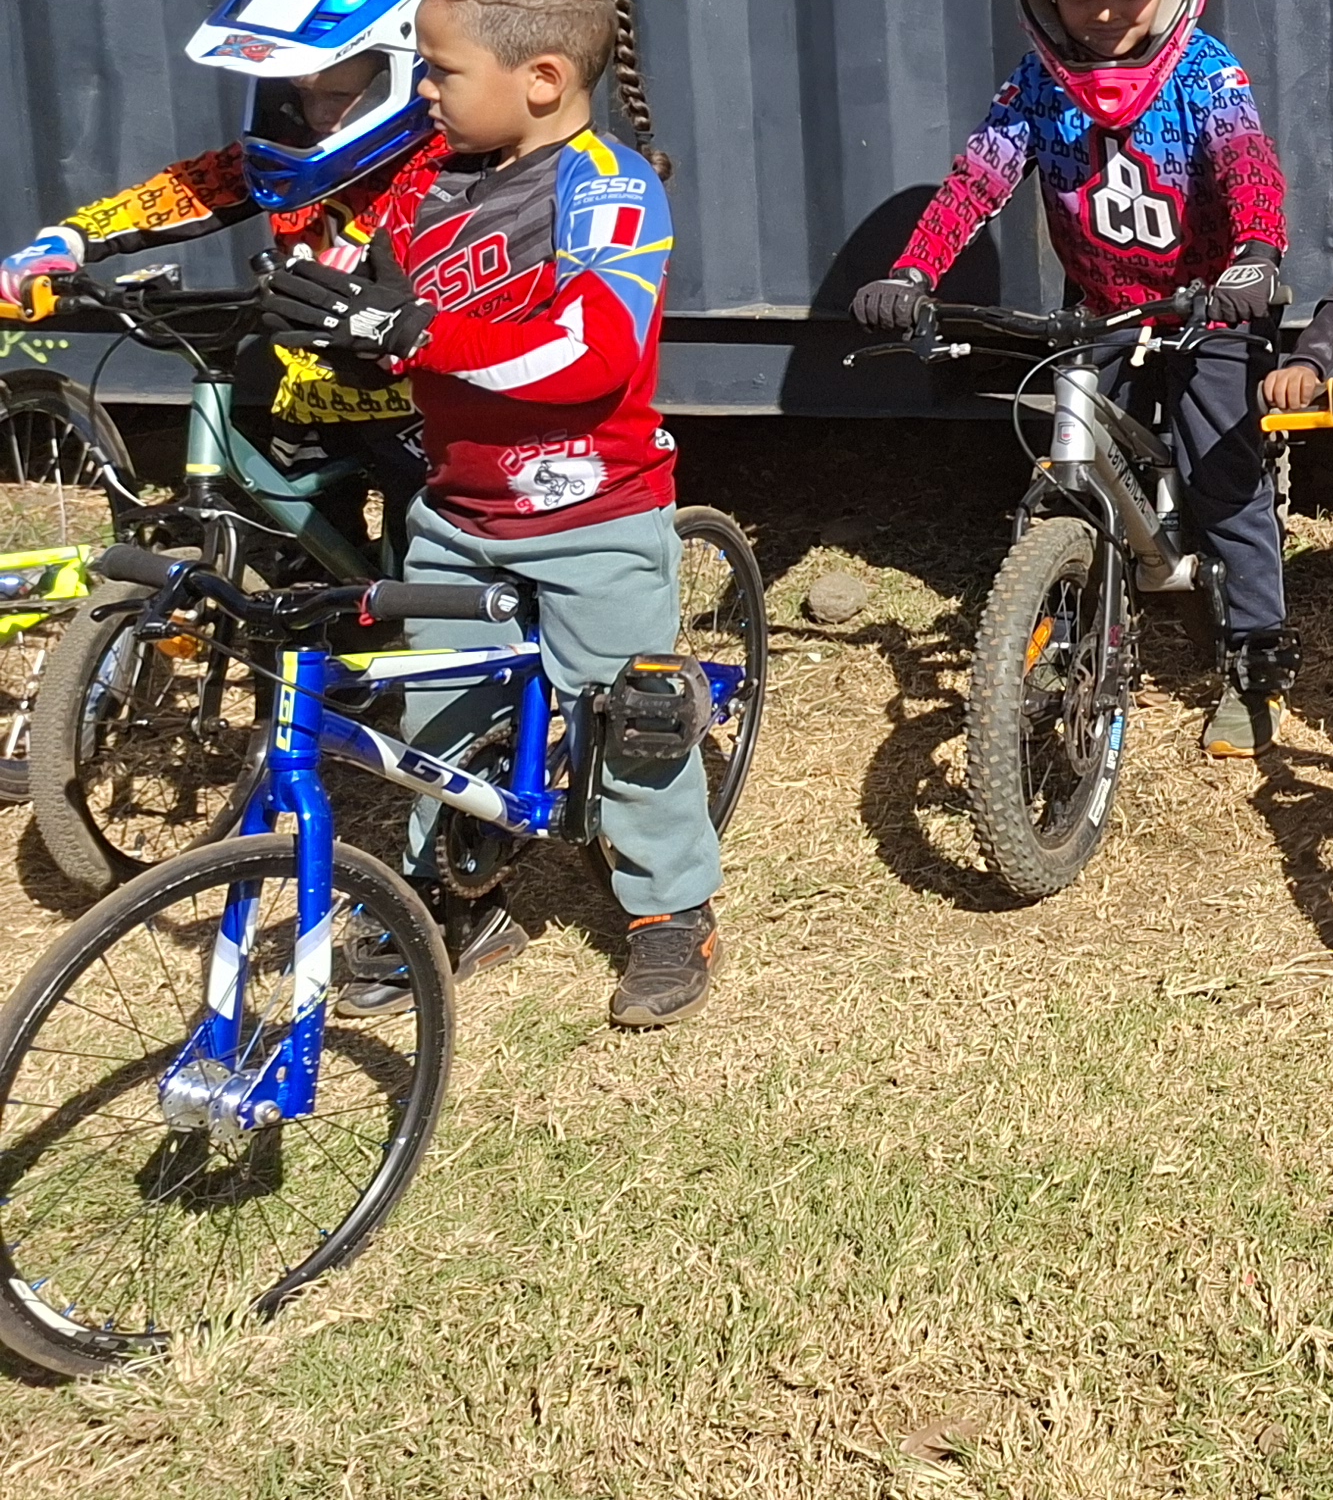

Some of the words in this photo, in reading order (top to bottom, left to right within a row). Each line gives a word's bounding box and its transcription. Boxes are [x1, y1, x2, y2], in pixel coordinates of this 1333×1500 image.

[334, 27, 374, 61] KENNY
[574, 177, 647, 199] CSSD
[413, 231, 511, 314] SSD
